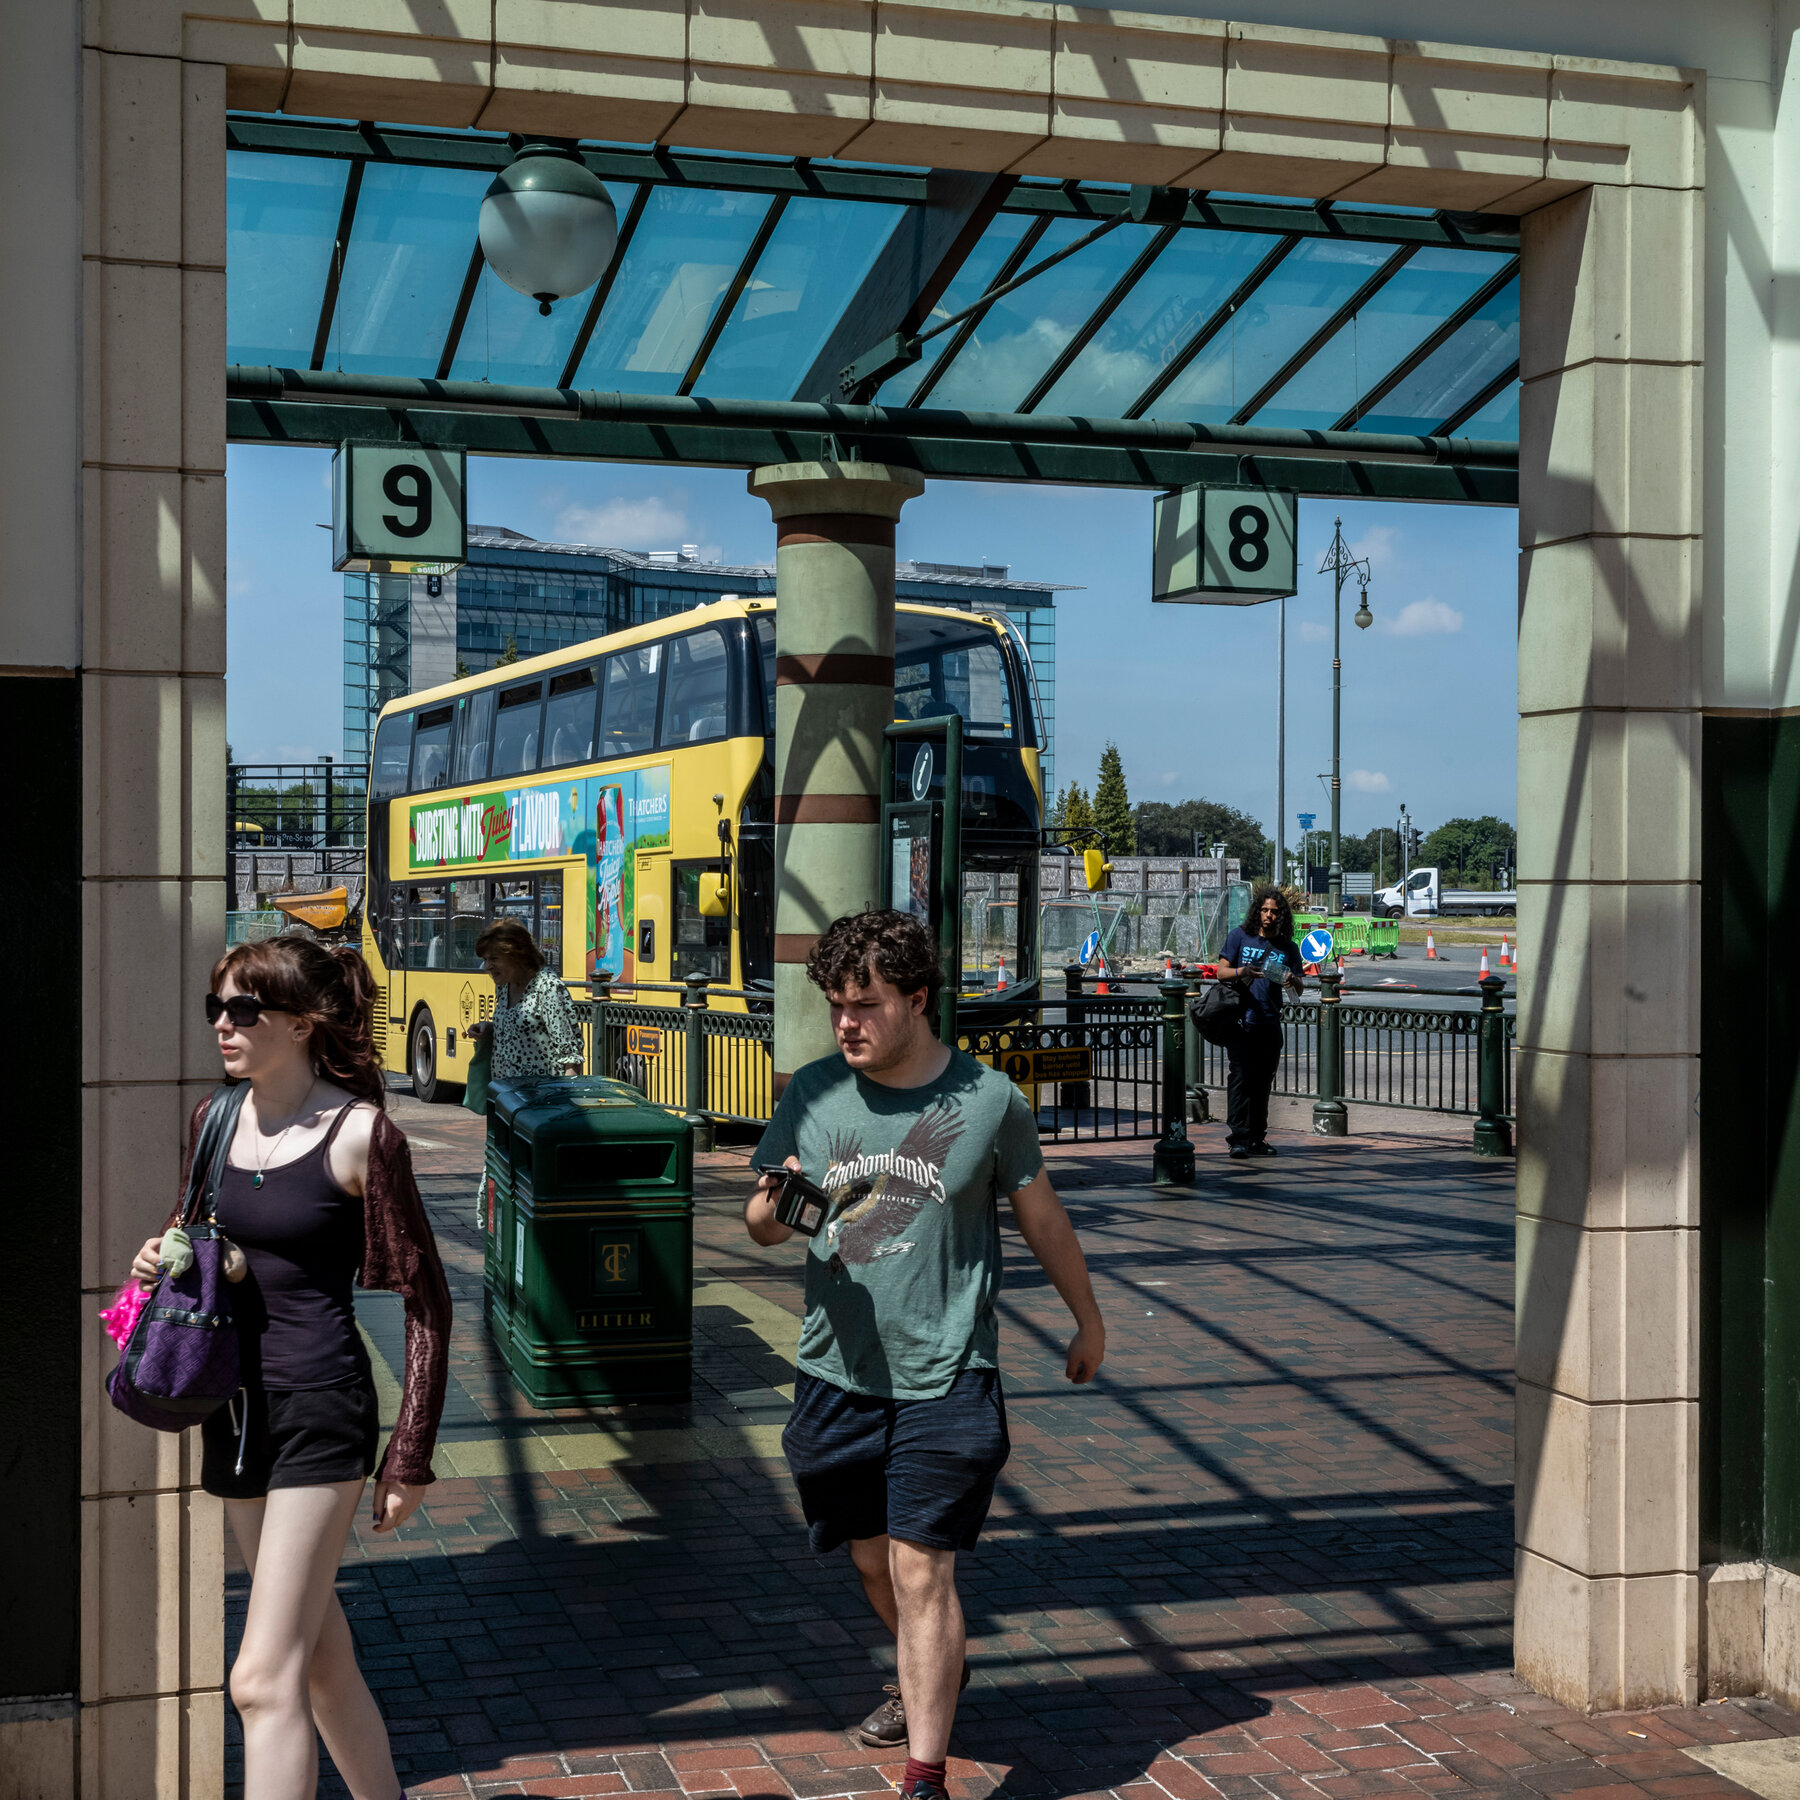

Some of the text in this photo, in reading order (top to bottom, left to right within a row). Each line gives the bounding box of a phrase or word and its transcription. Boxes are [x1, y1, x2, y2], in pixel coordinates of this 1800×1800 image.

[382, 463, 433, 539] 9
[1228, 504, 1270, 573] 8
[416, 791, 560, 862] BURSTING WITH Juicy FLAVOUR
[580, 1312, 652, 1328] LITTER
